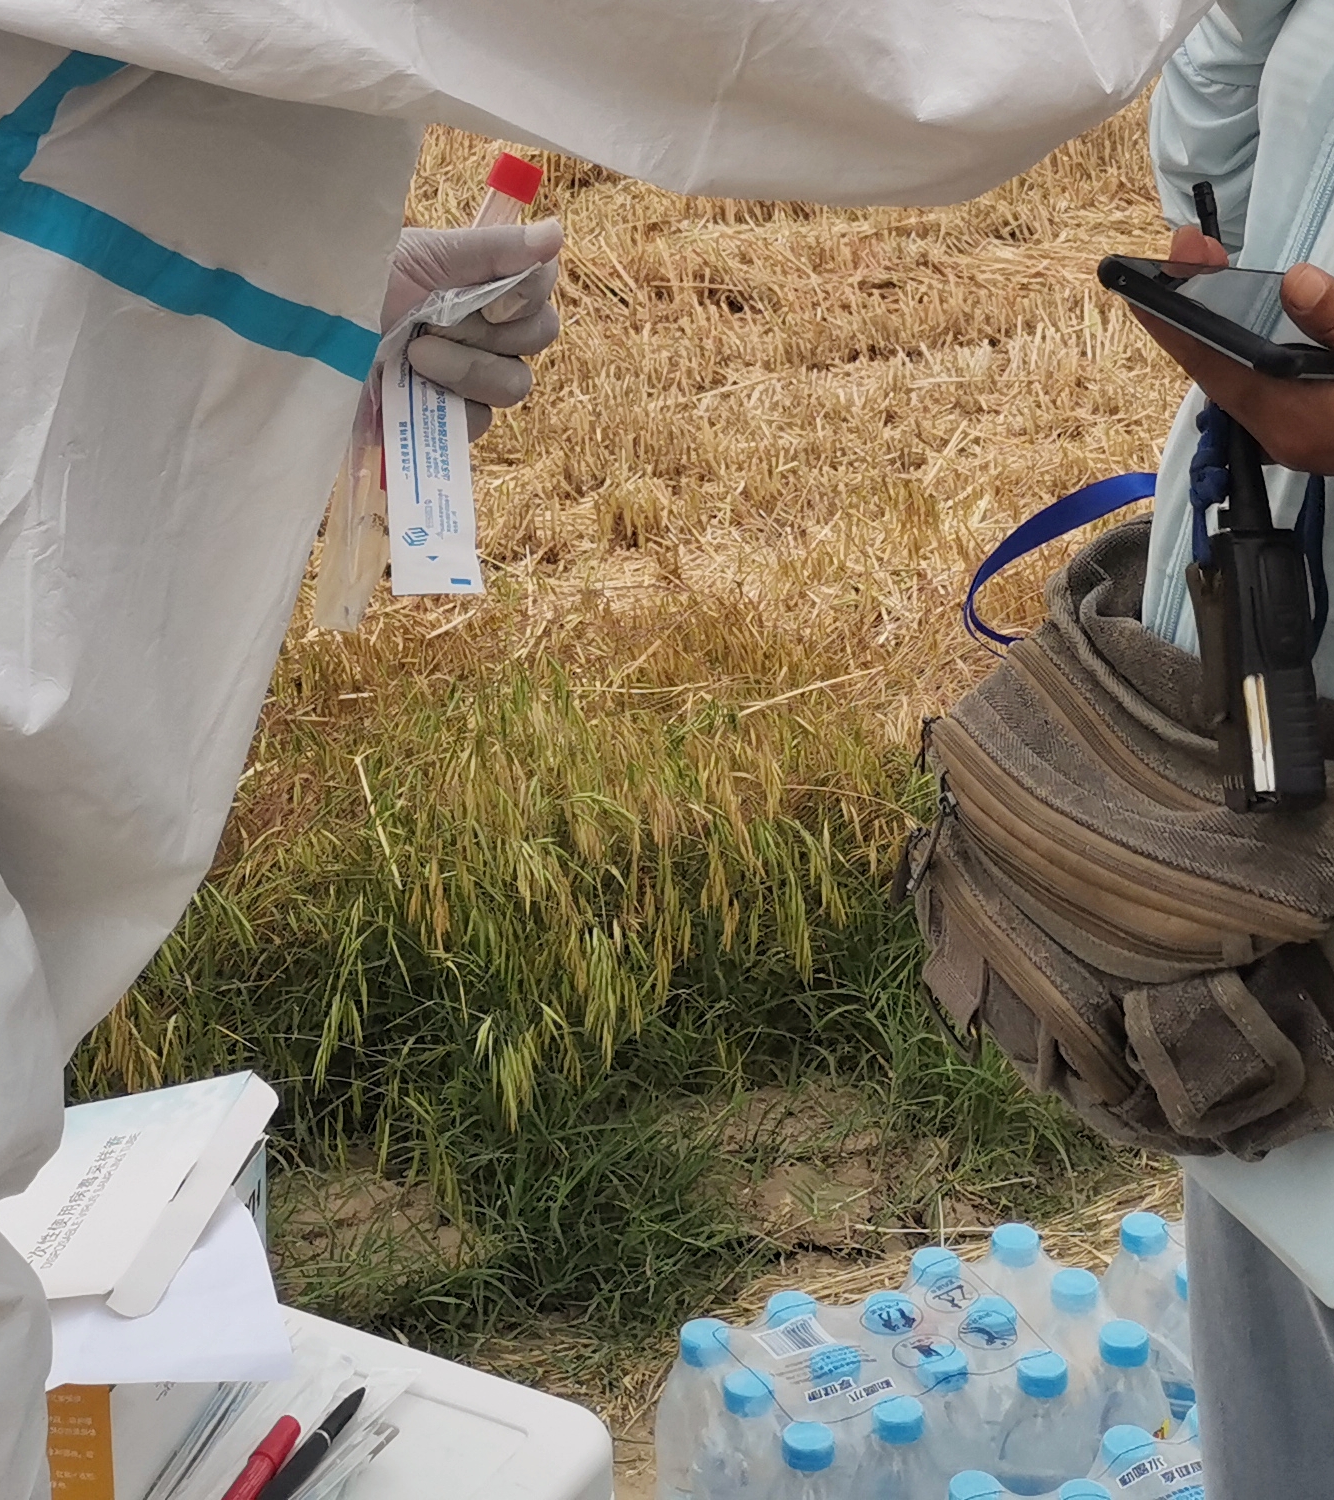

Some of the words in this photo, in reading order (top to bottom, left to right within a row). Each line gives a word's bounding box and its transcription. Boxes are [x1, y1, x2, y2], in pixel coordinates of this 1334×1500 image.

[26, 1135, 127, 1265] 次性使用病毒采样管
